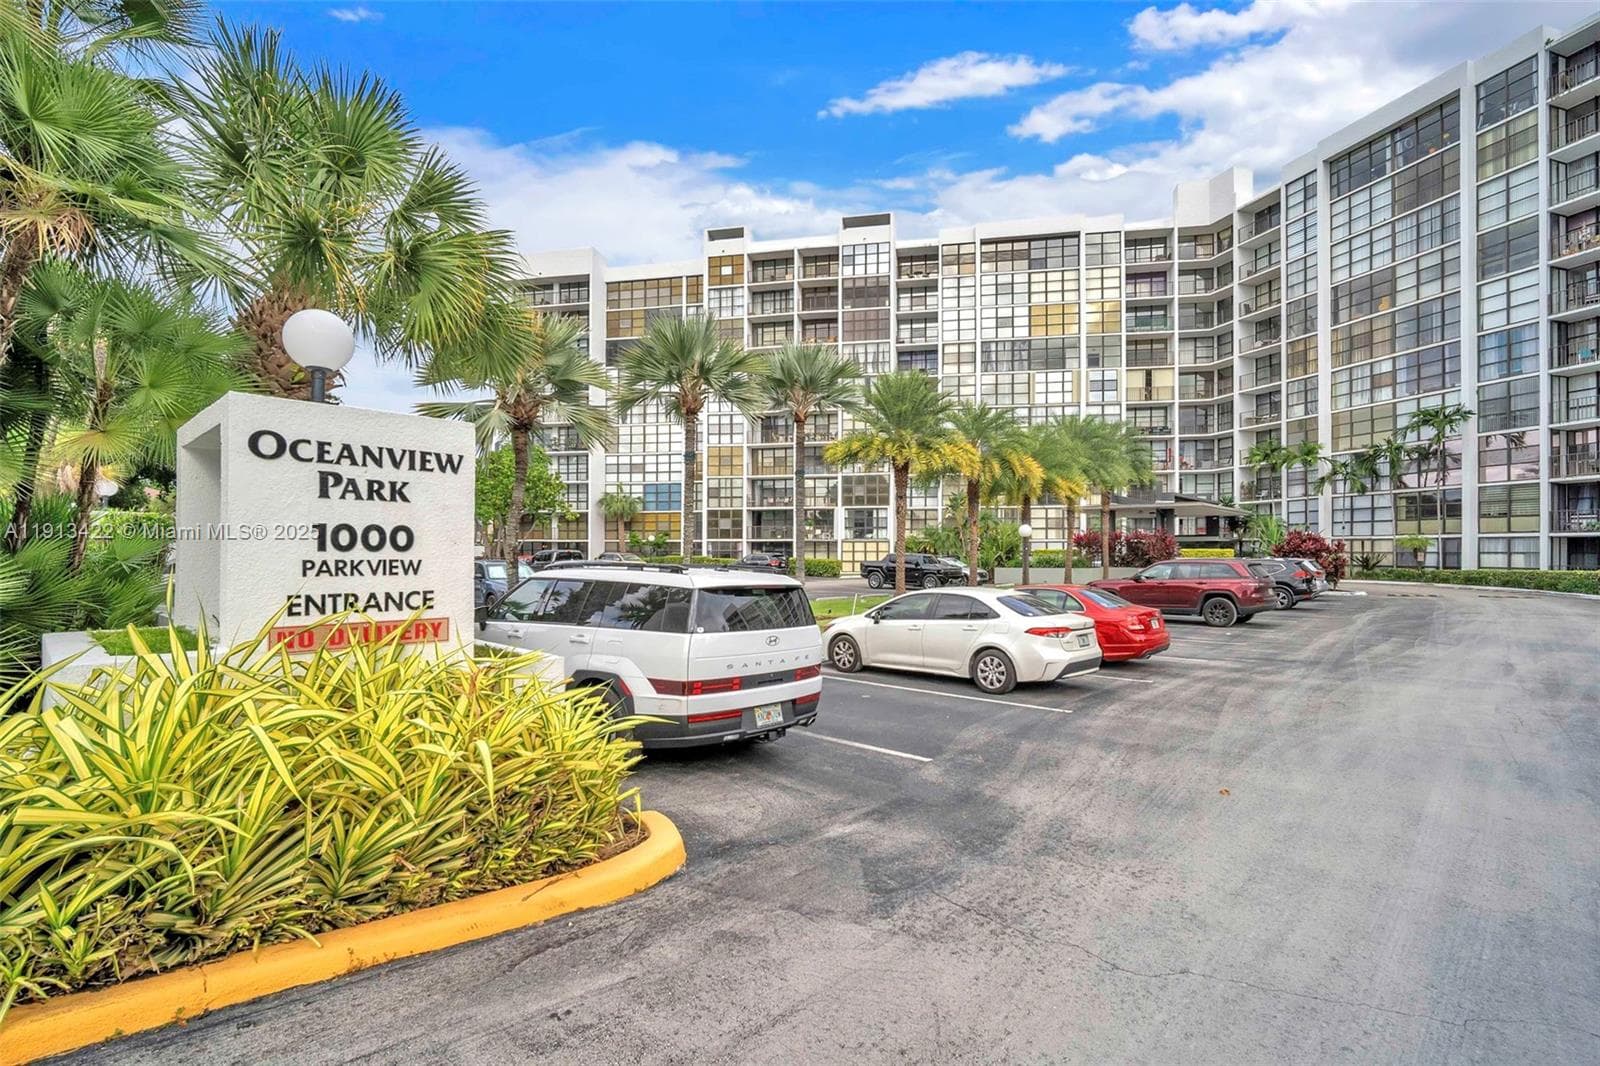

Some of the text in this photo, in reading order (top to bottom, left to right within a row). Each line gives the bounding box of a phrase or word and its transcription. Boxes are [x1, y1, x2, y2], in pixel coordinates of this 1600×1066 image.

[248, 430, 464, 474] OCEANVIEW
[317, 470, 411, 503] PARK
[312, 523, 415, 553] 1000
[301, 559, 422, 577] PARKVIEW
[287, 590, 435, 616] ENTRANCE
[276, 622, 442, 649] NO DLIVERY
